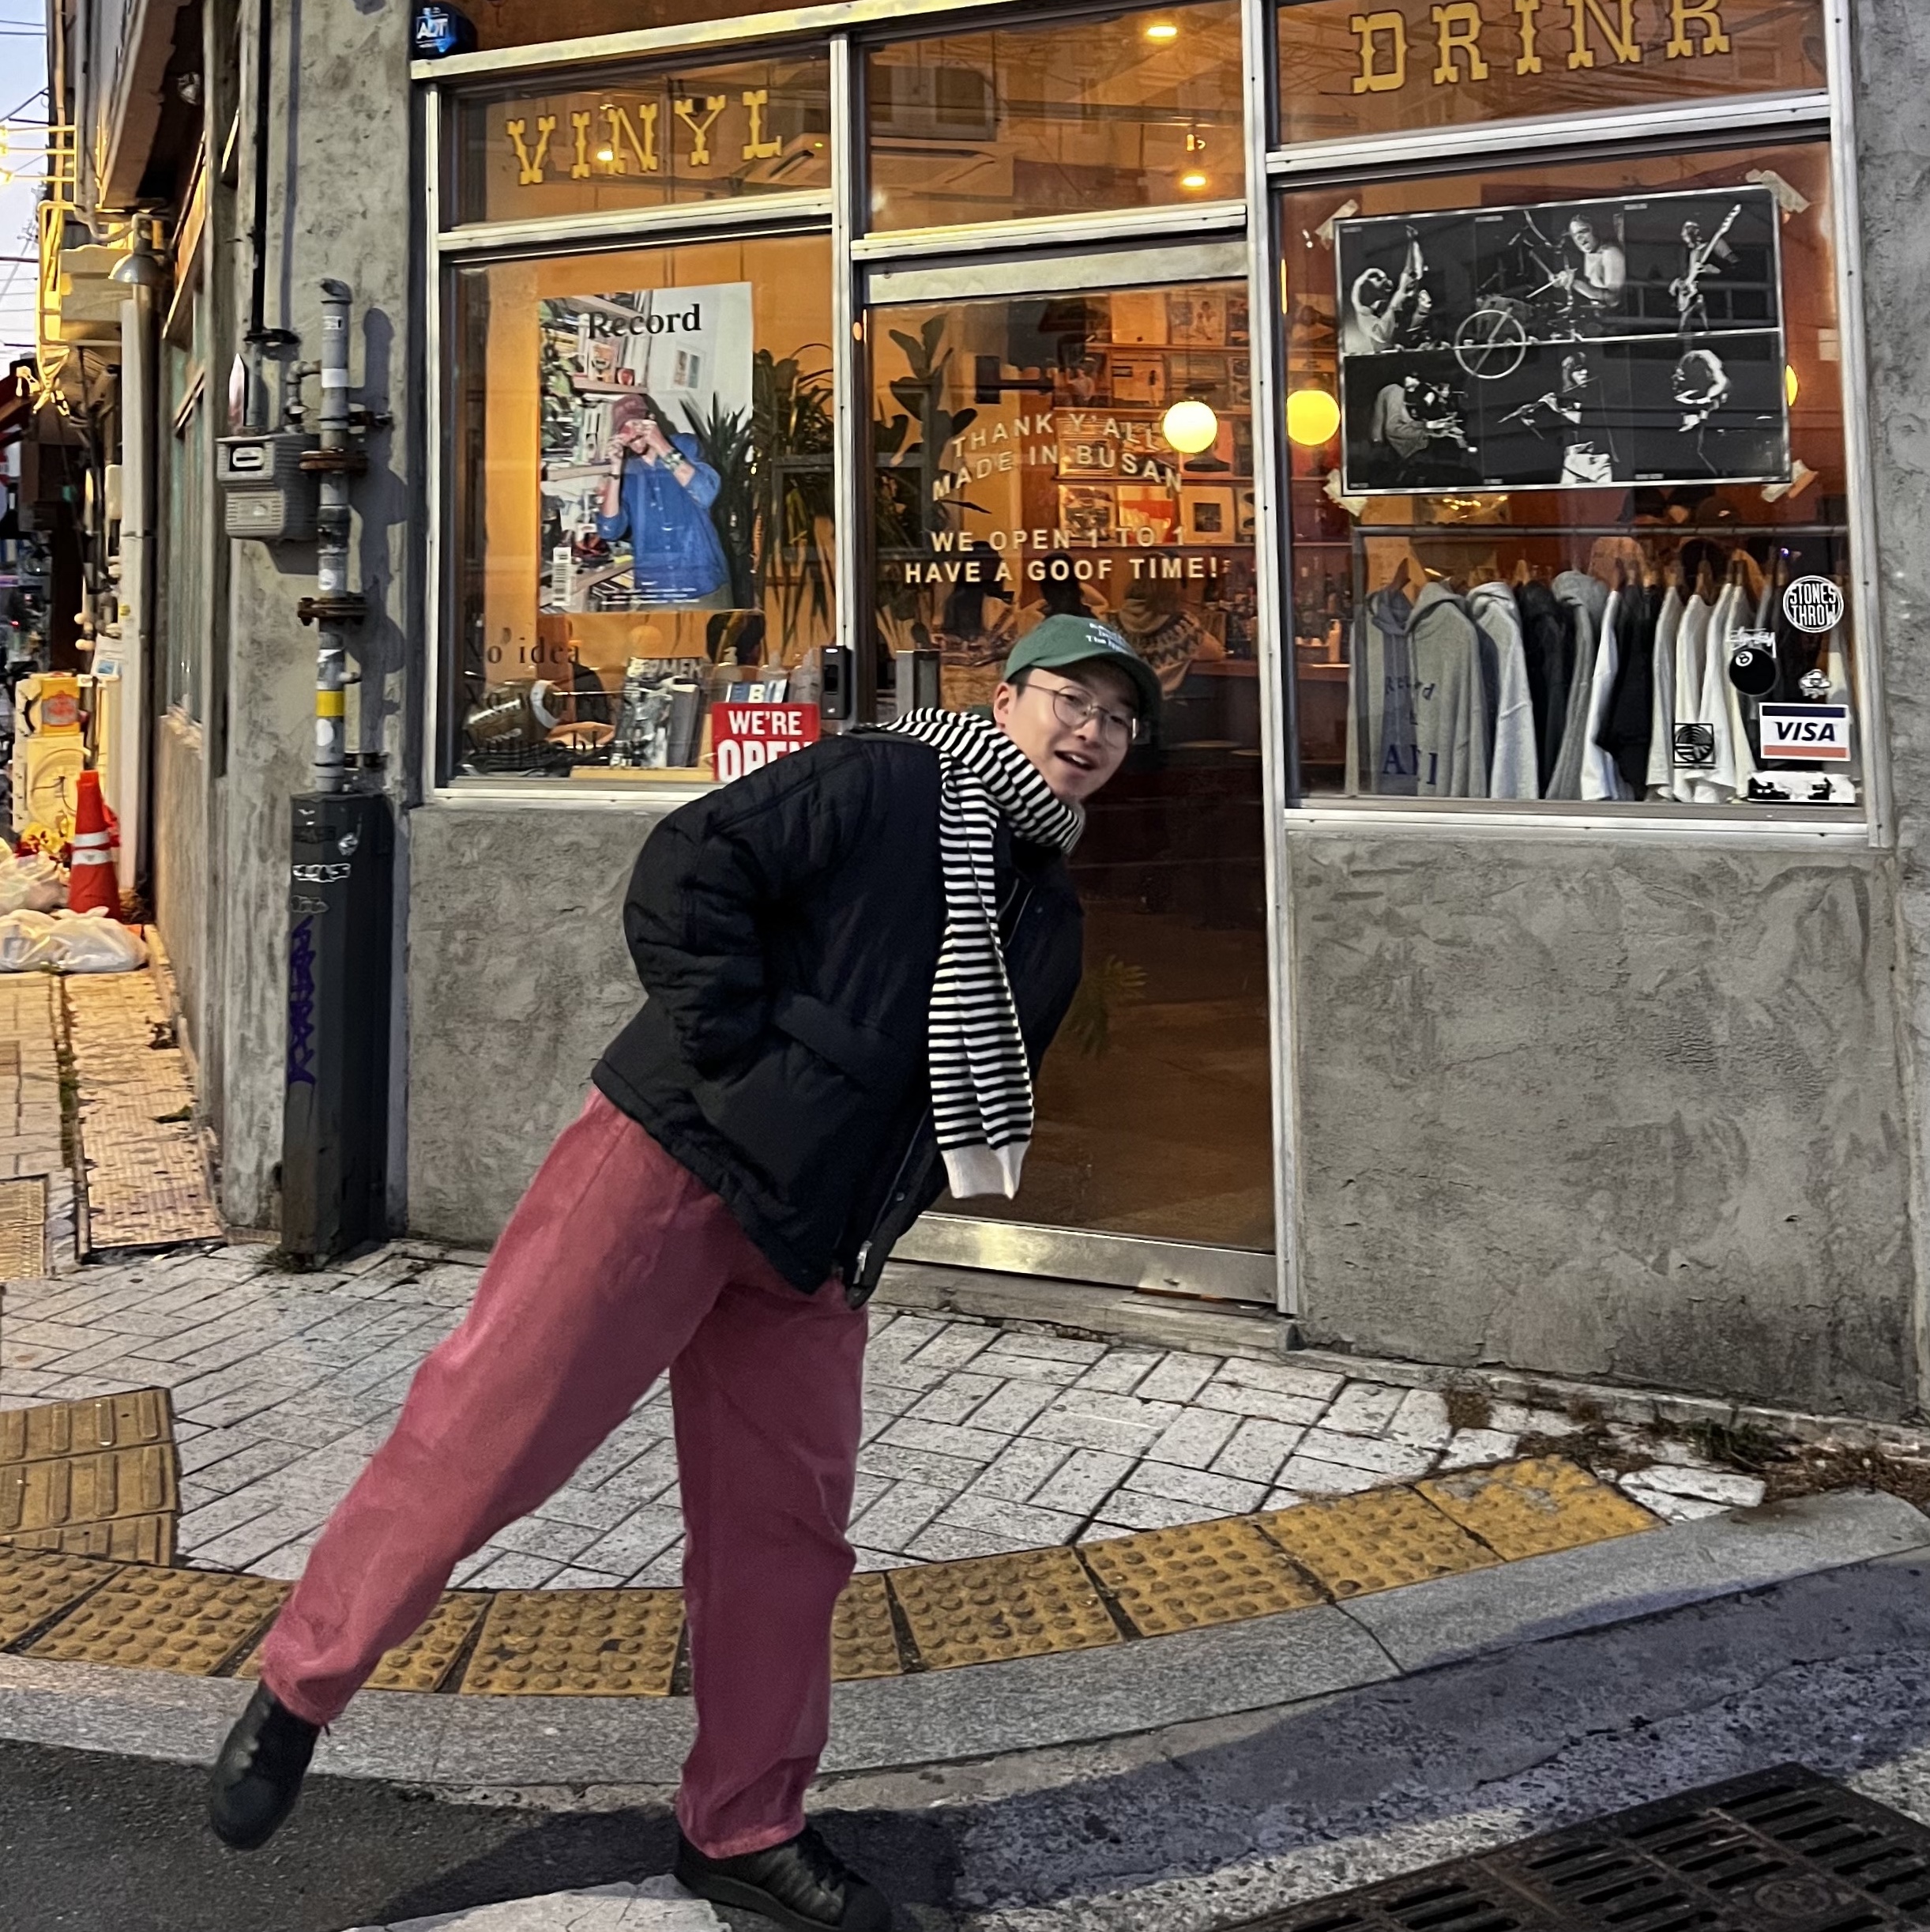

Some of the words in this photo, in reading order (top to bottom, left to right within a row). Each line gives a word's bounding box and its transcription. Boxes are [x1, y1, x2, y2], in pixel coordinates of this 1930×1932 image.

[417, 18, 448, 40] ADT
[506, 89, 782, 186] VINYL
[589, 303, 702, 339] Record
[952, 413, 1053, 458] THANK
[1069, 413, 1160, 451] Y'ALL
[933, 450, 1013, 501] MADE
[1029, 445, 1058, 465] IN
[1076, 445, 1181, 493] BUSAN
[931, 532, 974, 552] WE
[989, 529, 1070, 550] OPEN
[1087, 529, 1097, 548] 1
[1115, 527, 1154, 547] TO
[1172, 526, 1183, 546] 1
[905, 562, 981, 583] HAVE
[994, 562, 1013, 582] A
[1028, 559, 1113, 581] GOOF
[1128, 557, 1217, 579] TIME!
[1789, 582, 1837, 604] STONES
[1790, 604, 1836, 626] THROW
[519, 636, 579, 664] idea
[728, 710, 803, 736] WE'RE
[1774, 721, 1835, 742] VISA
[717, 739, 814, 782] OP
